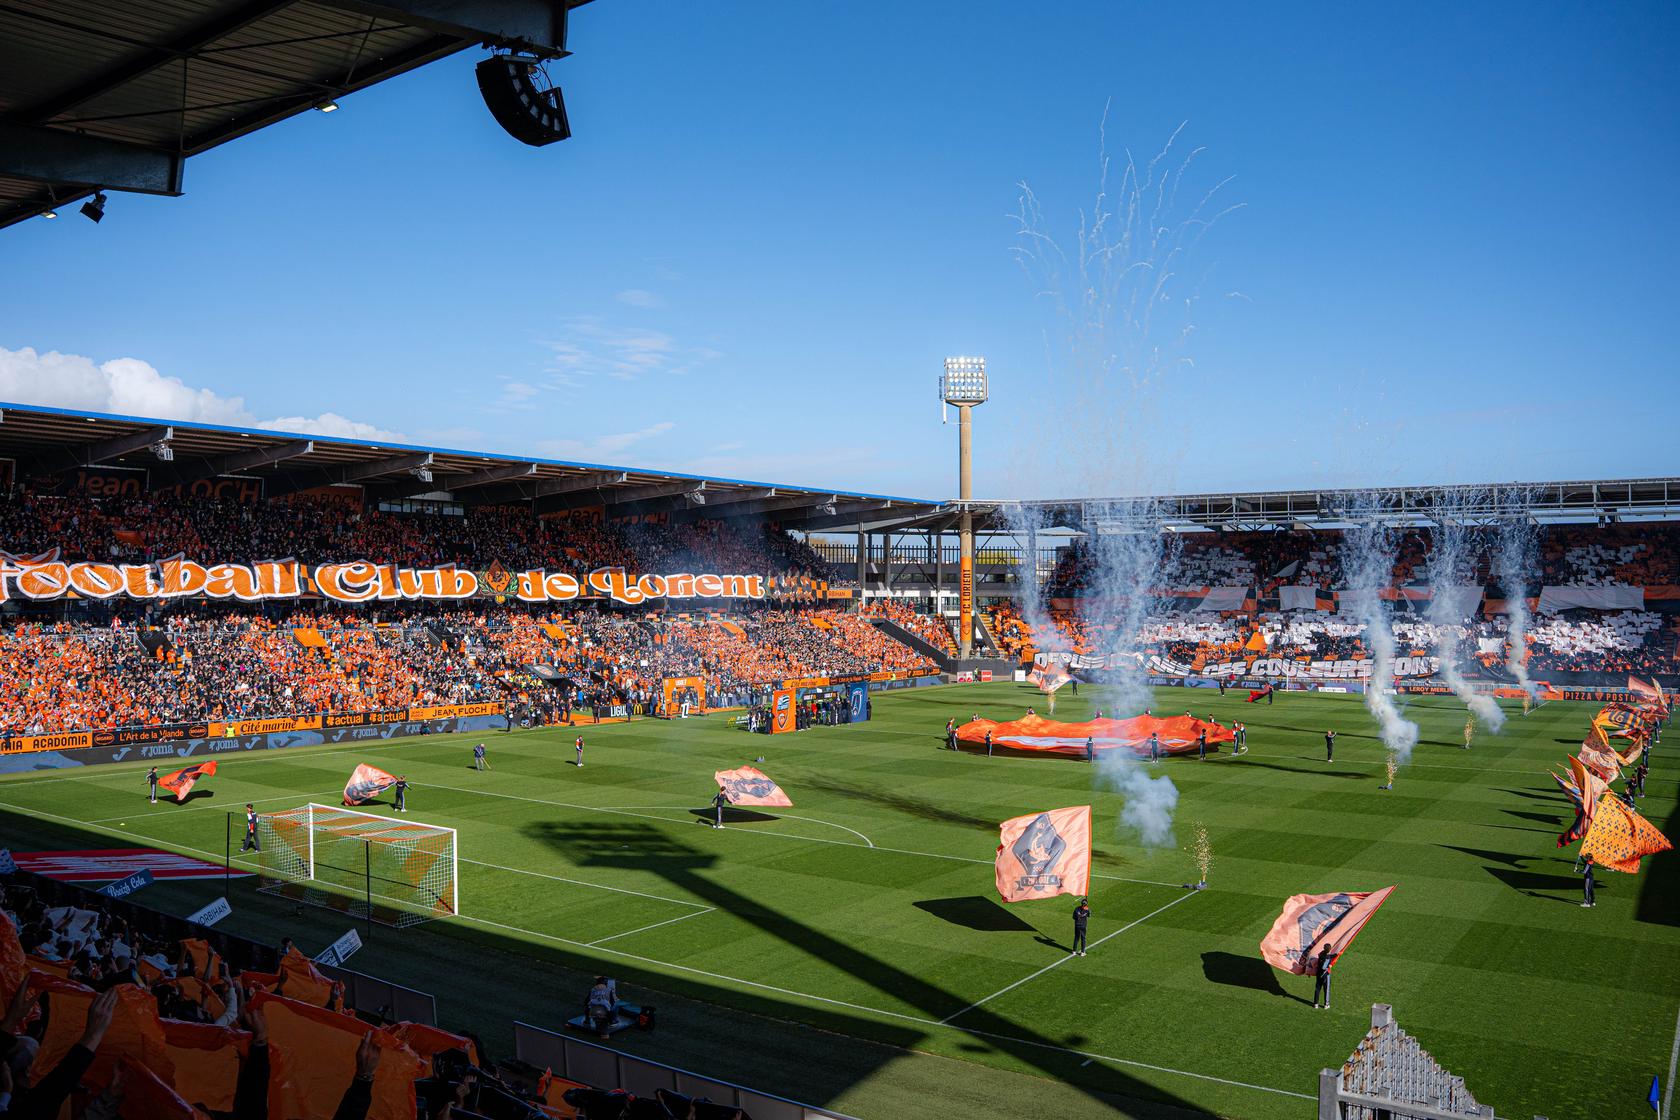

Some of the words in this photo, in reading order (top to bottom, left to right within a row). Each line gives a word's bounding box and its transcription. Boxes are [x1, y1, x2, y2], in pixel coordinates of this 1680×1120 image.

[314, 558, 479, 602] Club
[516, 567, 579, 601] de
[962, 568, 971, 601] LORIENT
[962, 603, 971, 614] FC
[1564, 691, 1592, 701] PIZZA
[432, 707, 455, 718] JEAN
[610, 704, 629, 717] LIGU
[334, 713, 364, 725] actual
[240, 721, 261, 733] Cité
[261, 719, 297, 732] marine
[33, 735, 88, 749] ACADOMIA
[119, 732, 138, 741] L'Art
[140, 732, 149, 740] de
[130, 875, 146, 888] Cola
